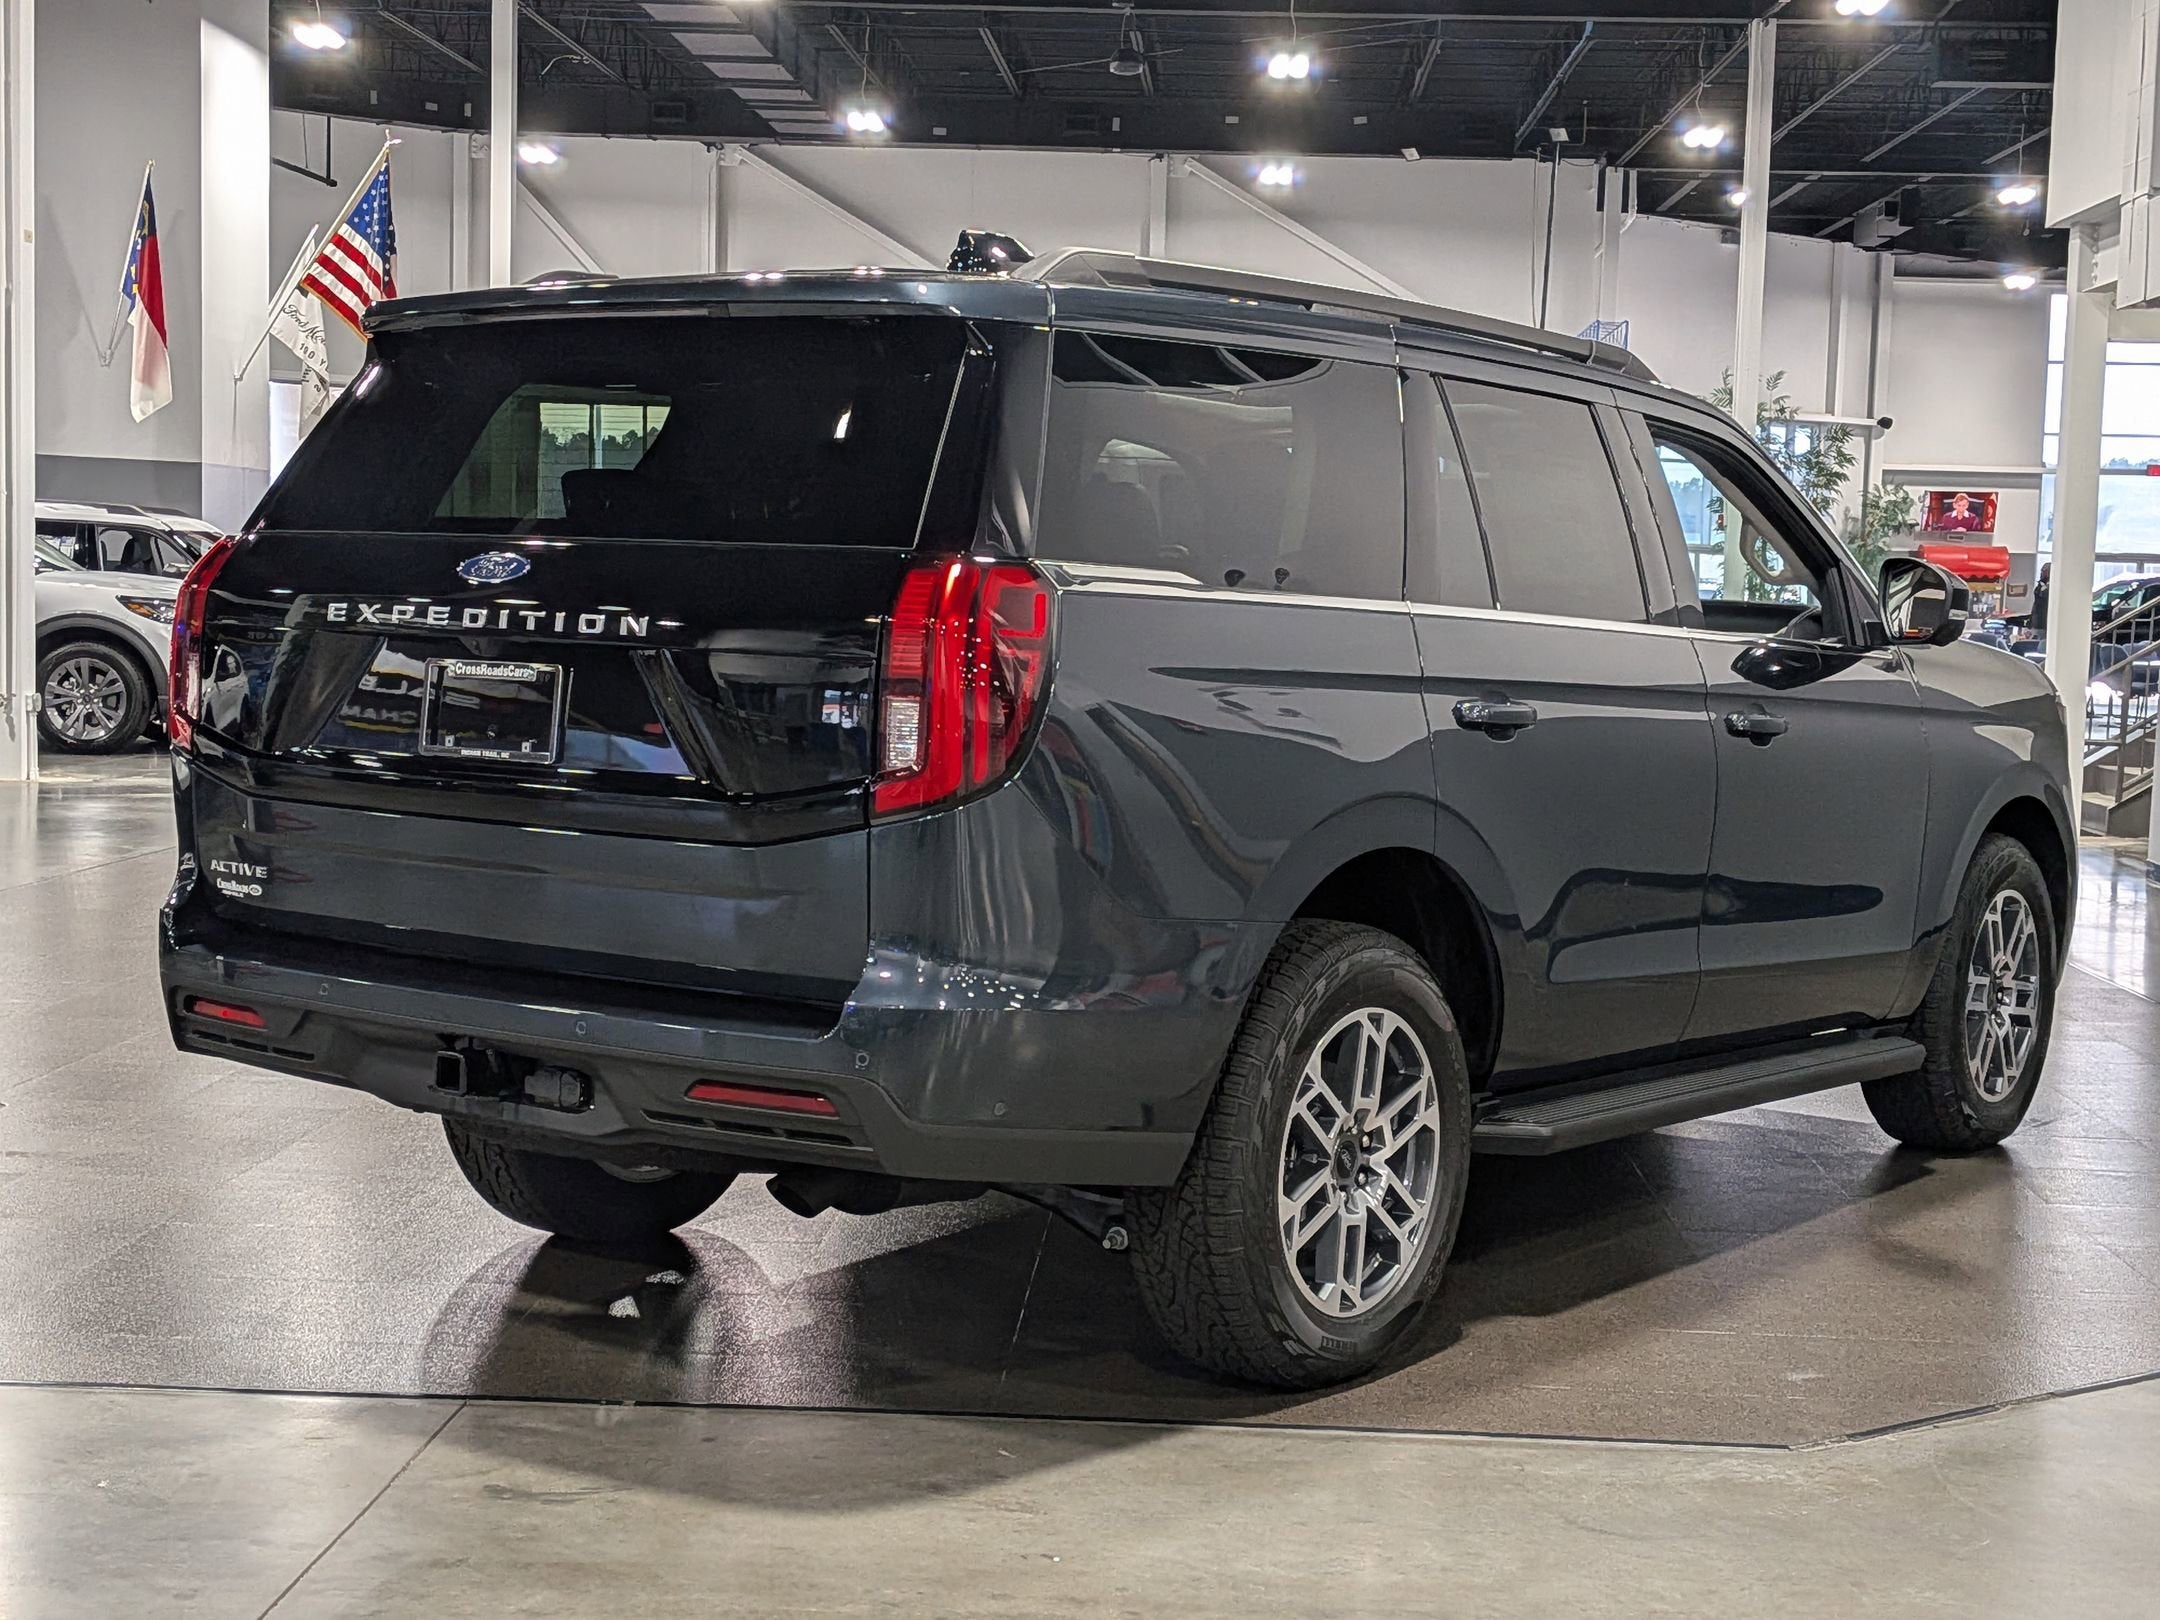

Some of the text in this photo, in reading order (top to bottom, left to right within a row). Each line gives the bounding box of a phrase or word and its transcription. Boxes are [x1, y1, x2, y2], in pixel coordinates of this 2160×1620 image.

[283, 304, 310, 328] Ford
[326, 601, 650, 637] EXPEDITION
[210, 859, 268, 879] ACTIVE
